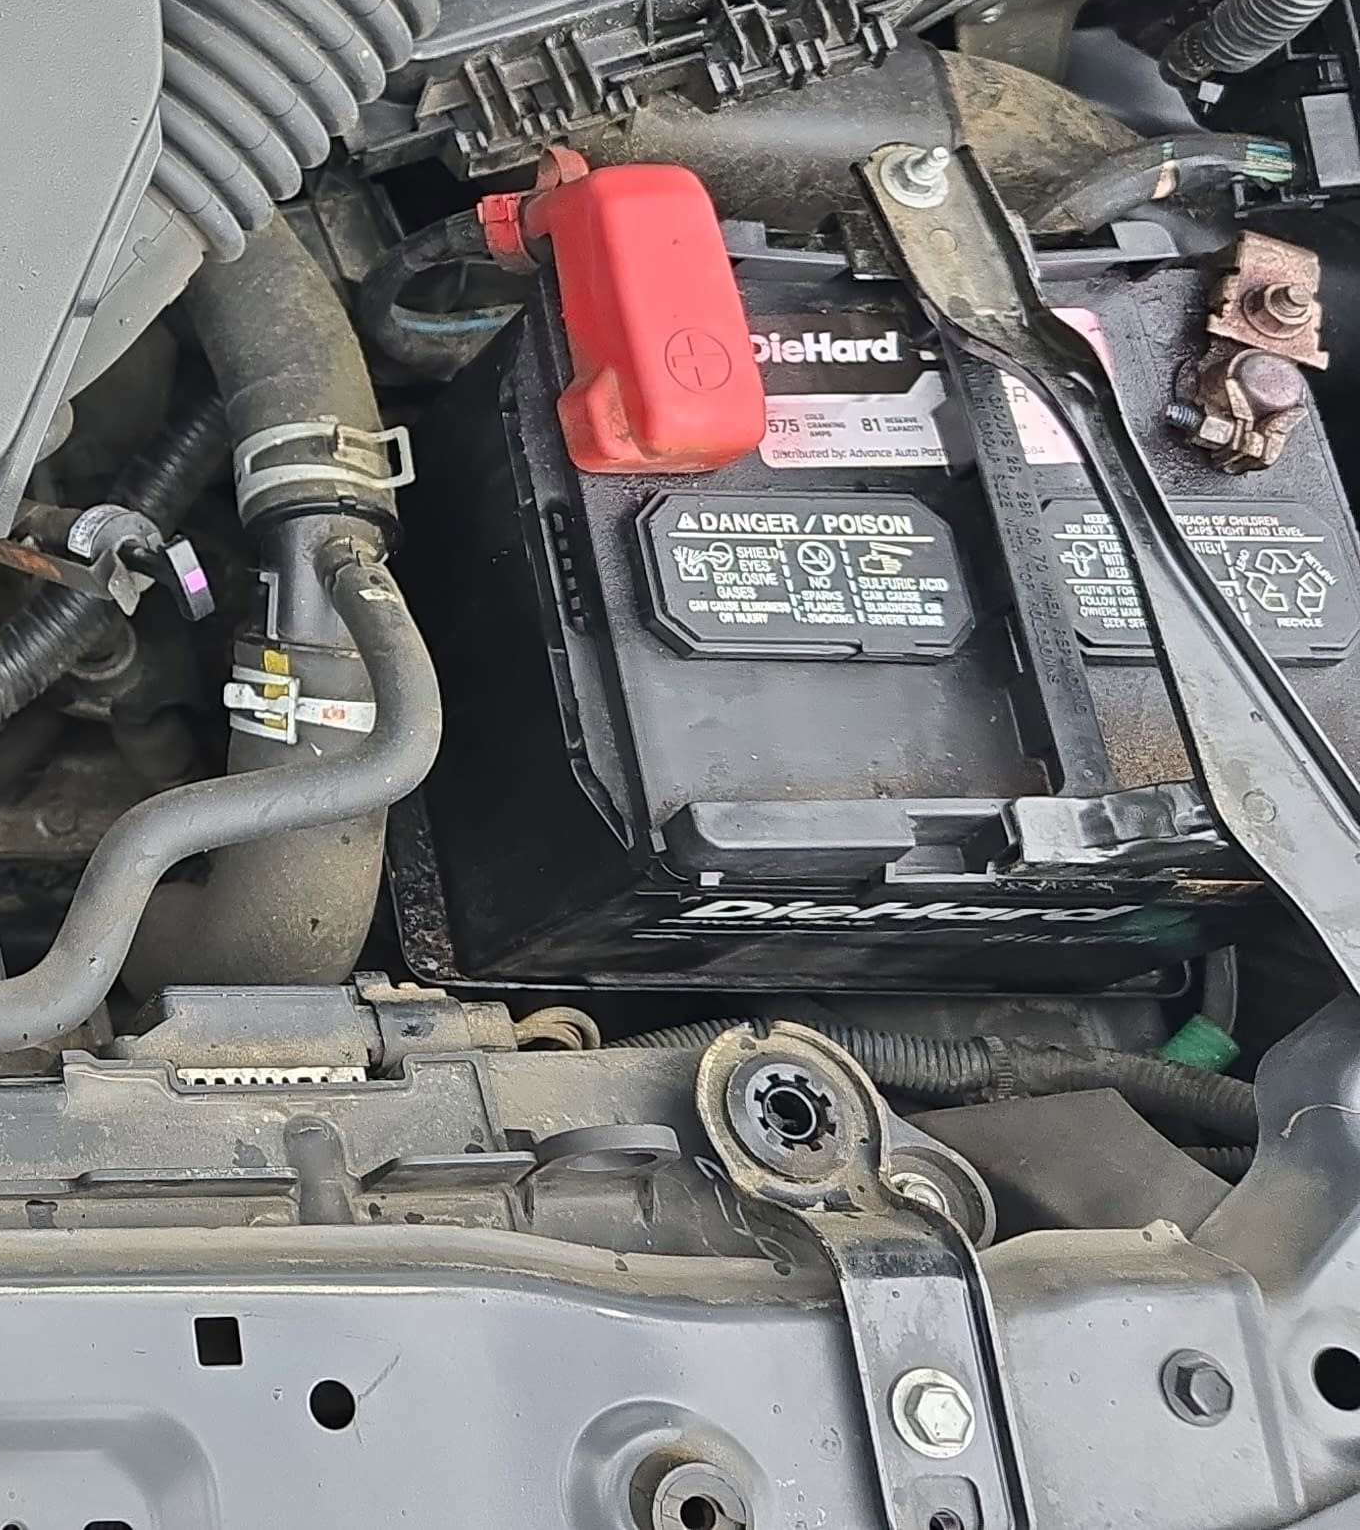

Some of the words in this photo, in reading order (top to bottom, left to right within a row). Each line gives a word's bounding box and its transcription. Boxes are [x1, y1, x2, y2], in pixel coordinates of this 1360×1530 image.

[748, 331, 899, 363] DieHard
[768, 419, 800, 433] 575
[861, 418, 882, 432] 81
[772, 448, 829, 459] Distributed
[831, 448, 846, 460] by:
[849, 448, 892, 459] Advance
[895, 448, 919, 458] Auto
[700, 512, 799, 532] DANGER
[822, 514, 914, 534] POISON
[1212, 515, 1228, 526] OF
[1229, 515, 1279, 527] CHILDREN
[1065, 524, 1081, 534] DO
[1082, 524, 1104, 534] NOT
[1186, 527, 1214, 536] CAPS
[1216, 527, 1246, 536] TIGHT
[1249, 528, 1270, 536] AND
[1273, 527, 1305, 537] LEVEL
[736, 546, 779, 559] SHIELD
[738, 560, 771, 572] EYES
[1235, 549, 1250, 572] LEAD
[1301, 551, 1338, 586] RETURN
[712, 572, 779, 586] EXPLOSIVE
[808, 576, 831, 589] NO
[858, 576, 916, 590] SULFURIC
[918, 578, 949, 591] ACID
[716, 586, 757, 600] GASES
[801, 590, 844, 602] SPARKS
[1073, 585, 1113, 595] CAUTION
[861, 591, 885, 601] CAN
[886, 591, 921, 602] CAUSE
[1080, 596, 1117, 606] FOLLOW
[804, 602, 846, 613] FLAMES
[1080, 607, 1119, 618] OWNERS
[807, 613, 855, 625] SMOKING
[867, 614, 907, 626] SEVERE
[907, 615, 945, 626] BURNS
[1277, 617, 1323, 628] RECYCLE
[680, 899, 1144, 923] DieHard
